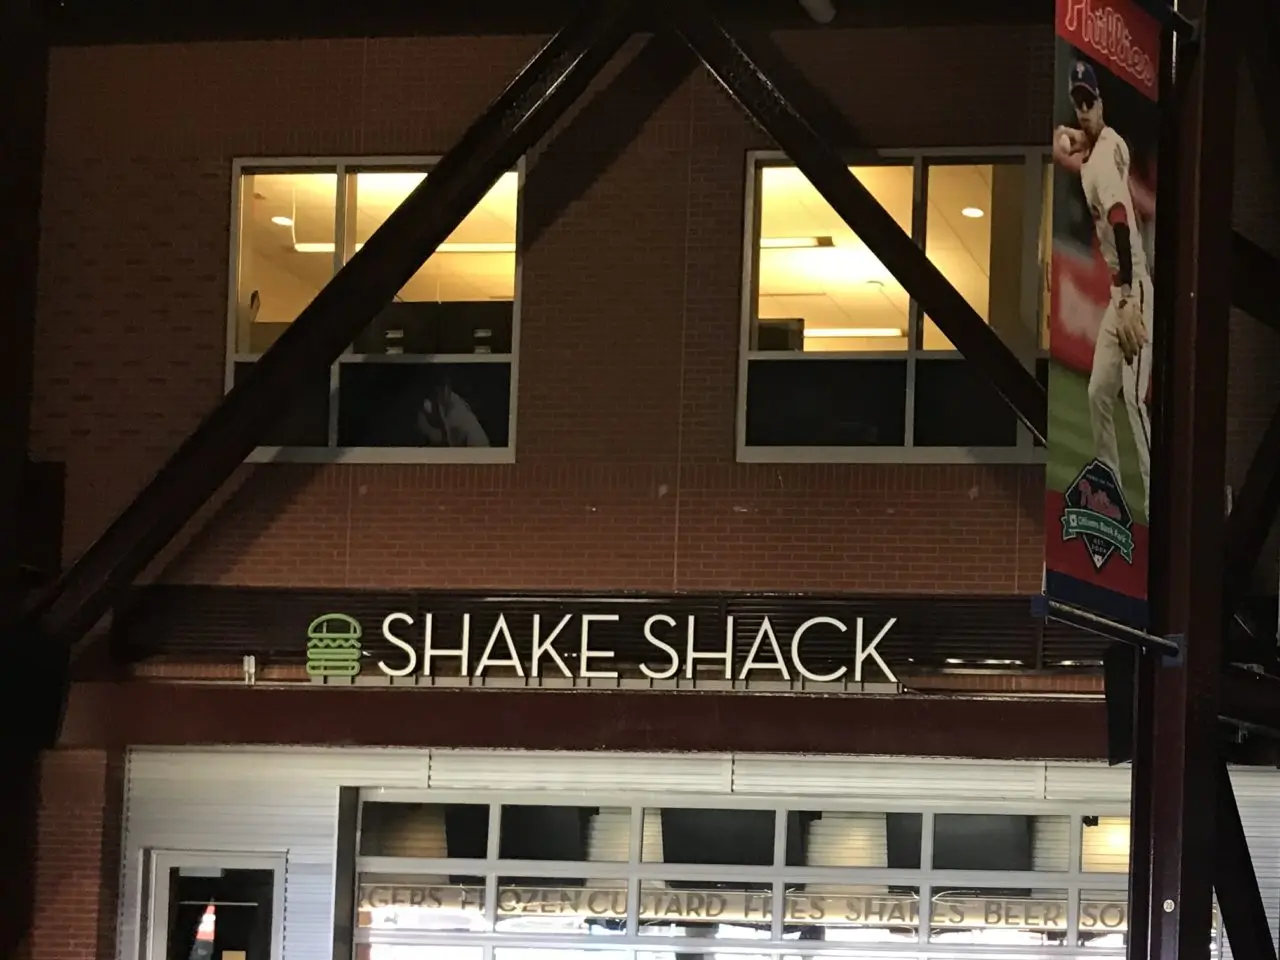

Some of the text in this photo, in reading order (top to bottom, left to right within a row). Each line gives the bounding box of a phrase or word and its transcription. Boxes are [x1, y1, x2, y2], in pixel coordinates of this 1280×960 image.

[378, 612, 898, 682] SHAKE SHACK
[587, 889, 727, 917] CUTARD
[744, 893, 826, 919] FRES
[984, 900, 1063, 926] BEER
